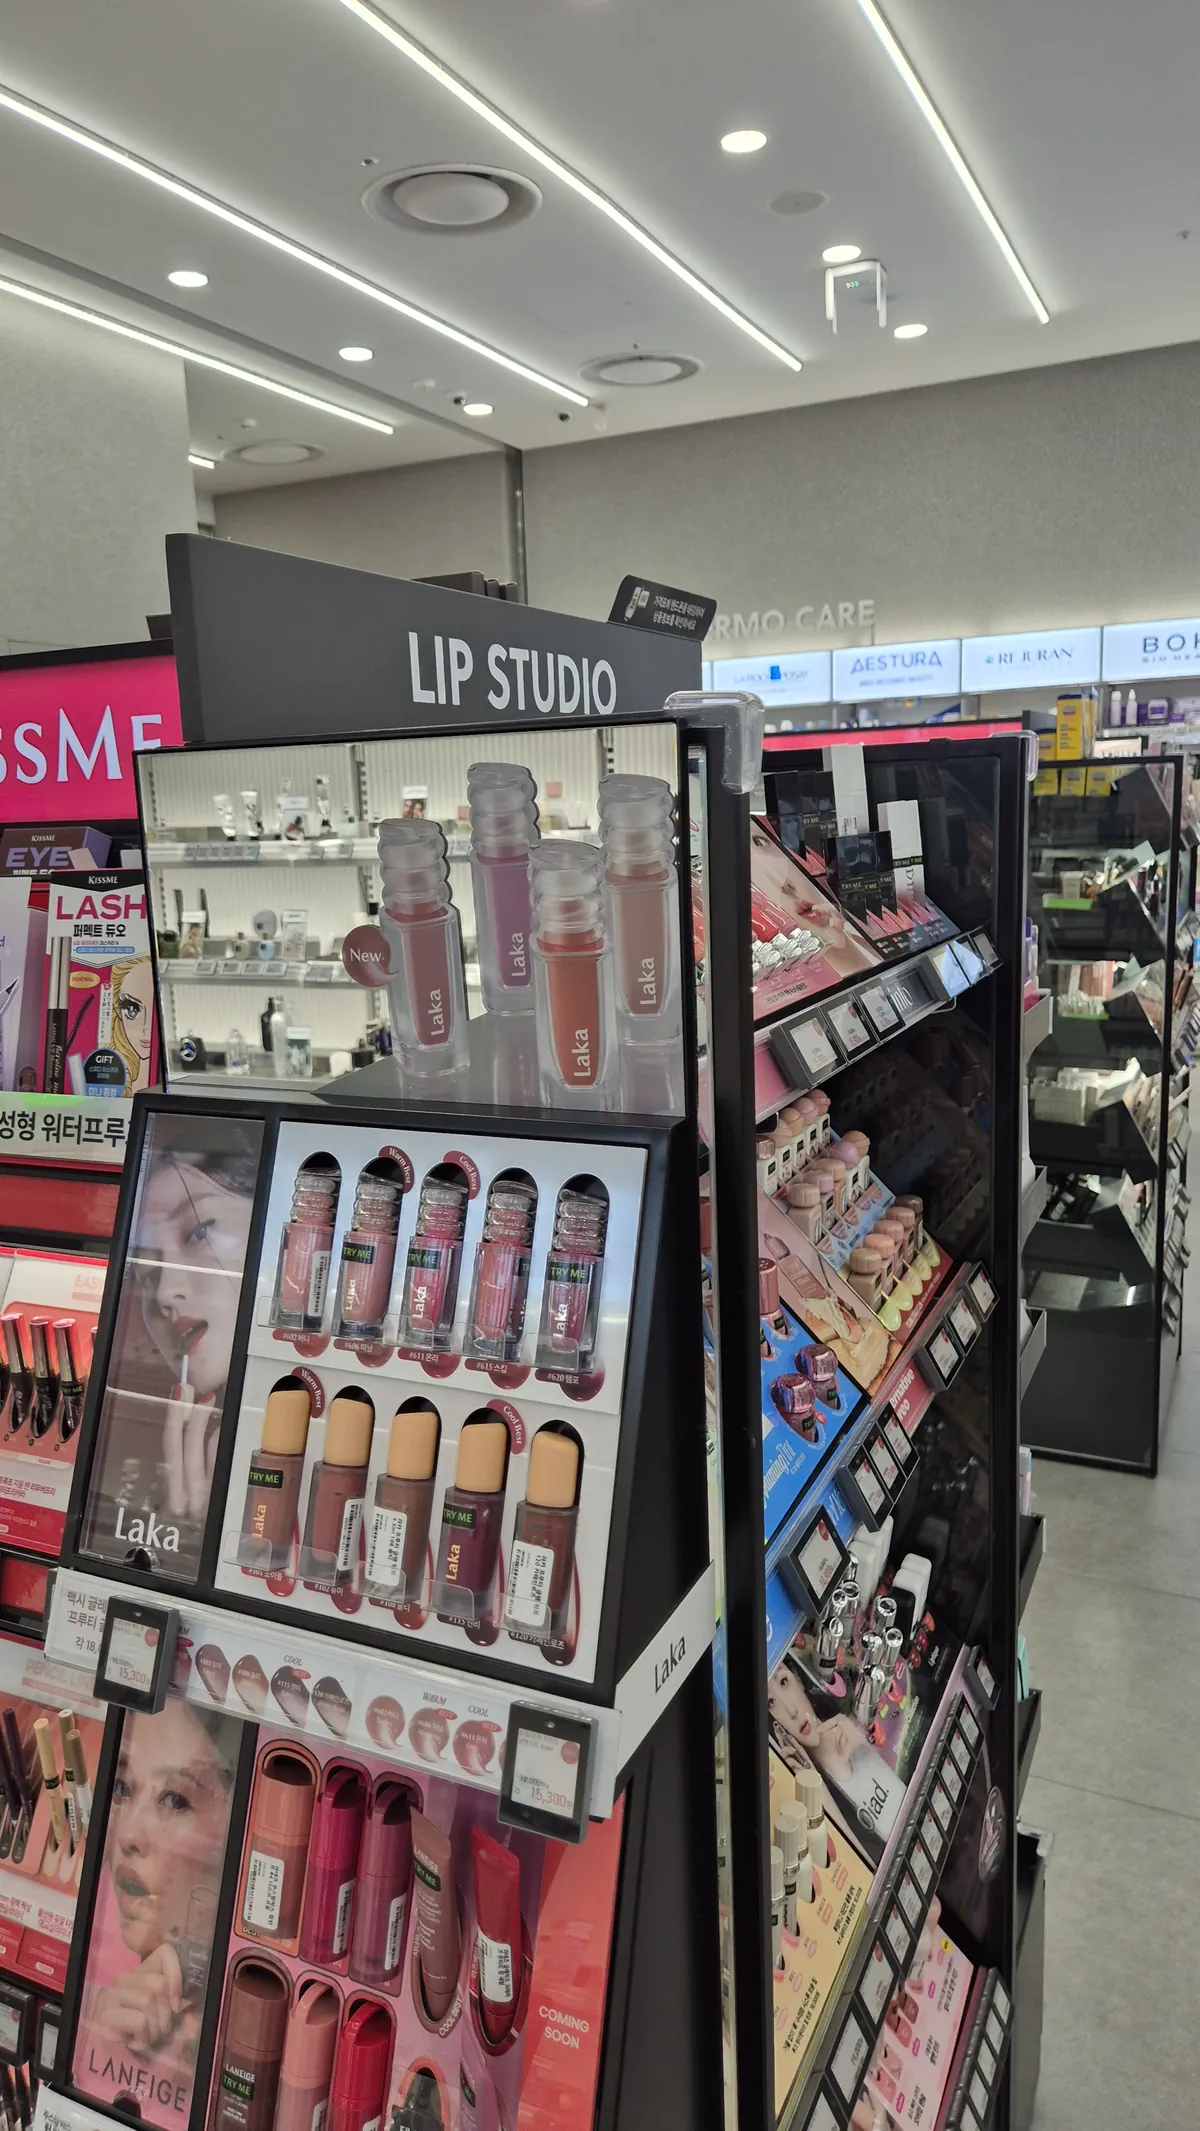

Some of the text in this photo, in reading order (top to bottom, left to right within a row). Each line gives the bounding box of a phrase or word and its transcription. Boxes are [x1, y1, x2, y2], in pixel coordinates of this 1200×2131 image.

[796, 599, 875, 631] CARE
[408, 631, 617, 715] LIP STUDIO
[849, 650, 943, 675] AESTURA
[0, 704, 163, 785] SME
[6, 845, 72, 868] EYE
[56, 893, 148, 920] LASH
[73, 924, 126, 938] 퍼펙트 듀오
[508, 932, 526, 977] Laka
[638, 957, 657, 1005] Laka
[428, 988, 444, 1037] Laka
[95, 1055, 114, 1065] GIFT
[572, 1027, 591, 1078] Laka
[88, 1087, 102, 1096] 미니
[41, 1113, 130, 1148] 워터프루
[389, 1148, 412, 1184] Warm Best
[459, 1155, 478, 1191] Cool Best
[343, 1247, 371, 1259] TRY ME
[408, 1254, 436, 1264] TRY ME
[551, 1267, 586, 1279] TRY ME
[412, 1285, 428, 1318] Laka
[552, 1303, 569, 1339] Laka
[345, 1341, 373, 1353] #606 미닝
[408, 1352, 438, 1363] #611 온리
[476, 1362, 508, 1374] #615 스킵
[547, 1372, 580, 1385] #620 템포
[301, 1369, 322, 1409] Warm Best
[503, 1405, 523, 1445] Cool Best
[250, 1472, 279, 1484] TRY ME
[115, 1506, 180, 1552] Laka
[251, 1504, 267, 1540] Laka
[443, 1508, 472, 1523] TRY ME
[445, 1543, 461, 1581] Laka
[67, 1610, 97, 1631] 프루티
[75, 1636, 84, 1650] 각
[283, 1654, 303, 1666] COOL
[654, 1635, 687, 1694] Laka
[422, 1691, 490, 1718] WARM COOL
[413, 1846, 439, 1873] LANEIGE
[427, 1872, 437, 1887] ME
[438, 1998, 463, 2037] COOL BEST
[539, 2005, 590, 2033] COMING
[545, 2026, 580, 2050] SOON
[89, 2048, 188, 2113] LANEIGE
[223, 2073, 251, 2096] TRY ME
[225, 2063, 256, 2084] LANEIGE
